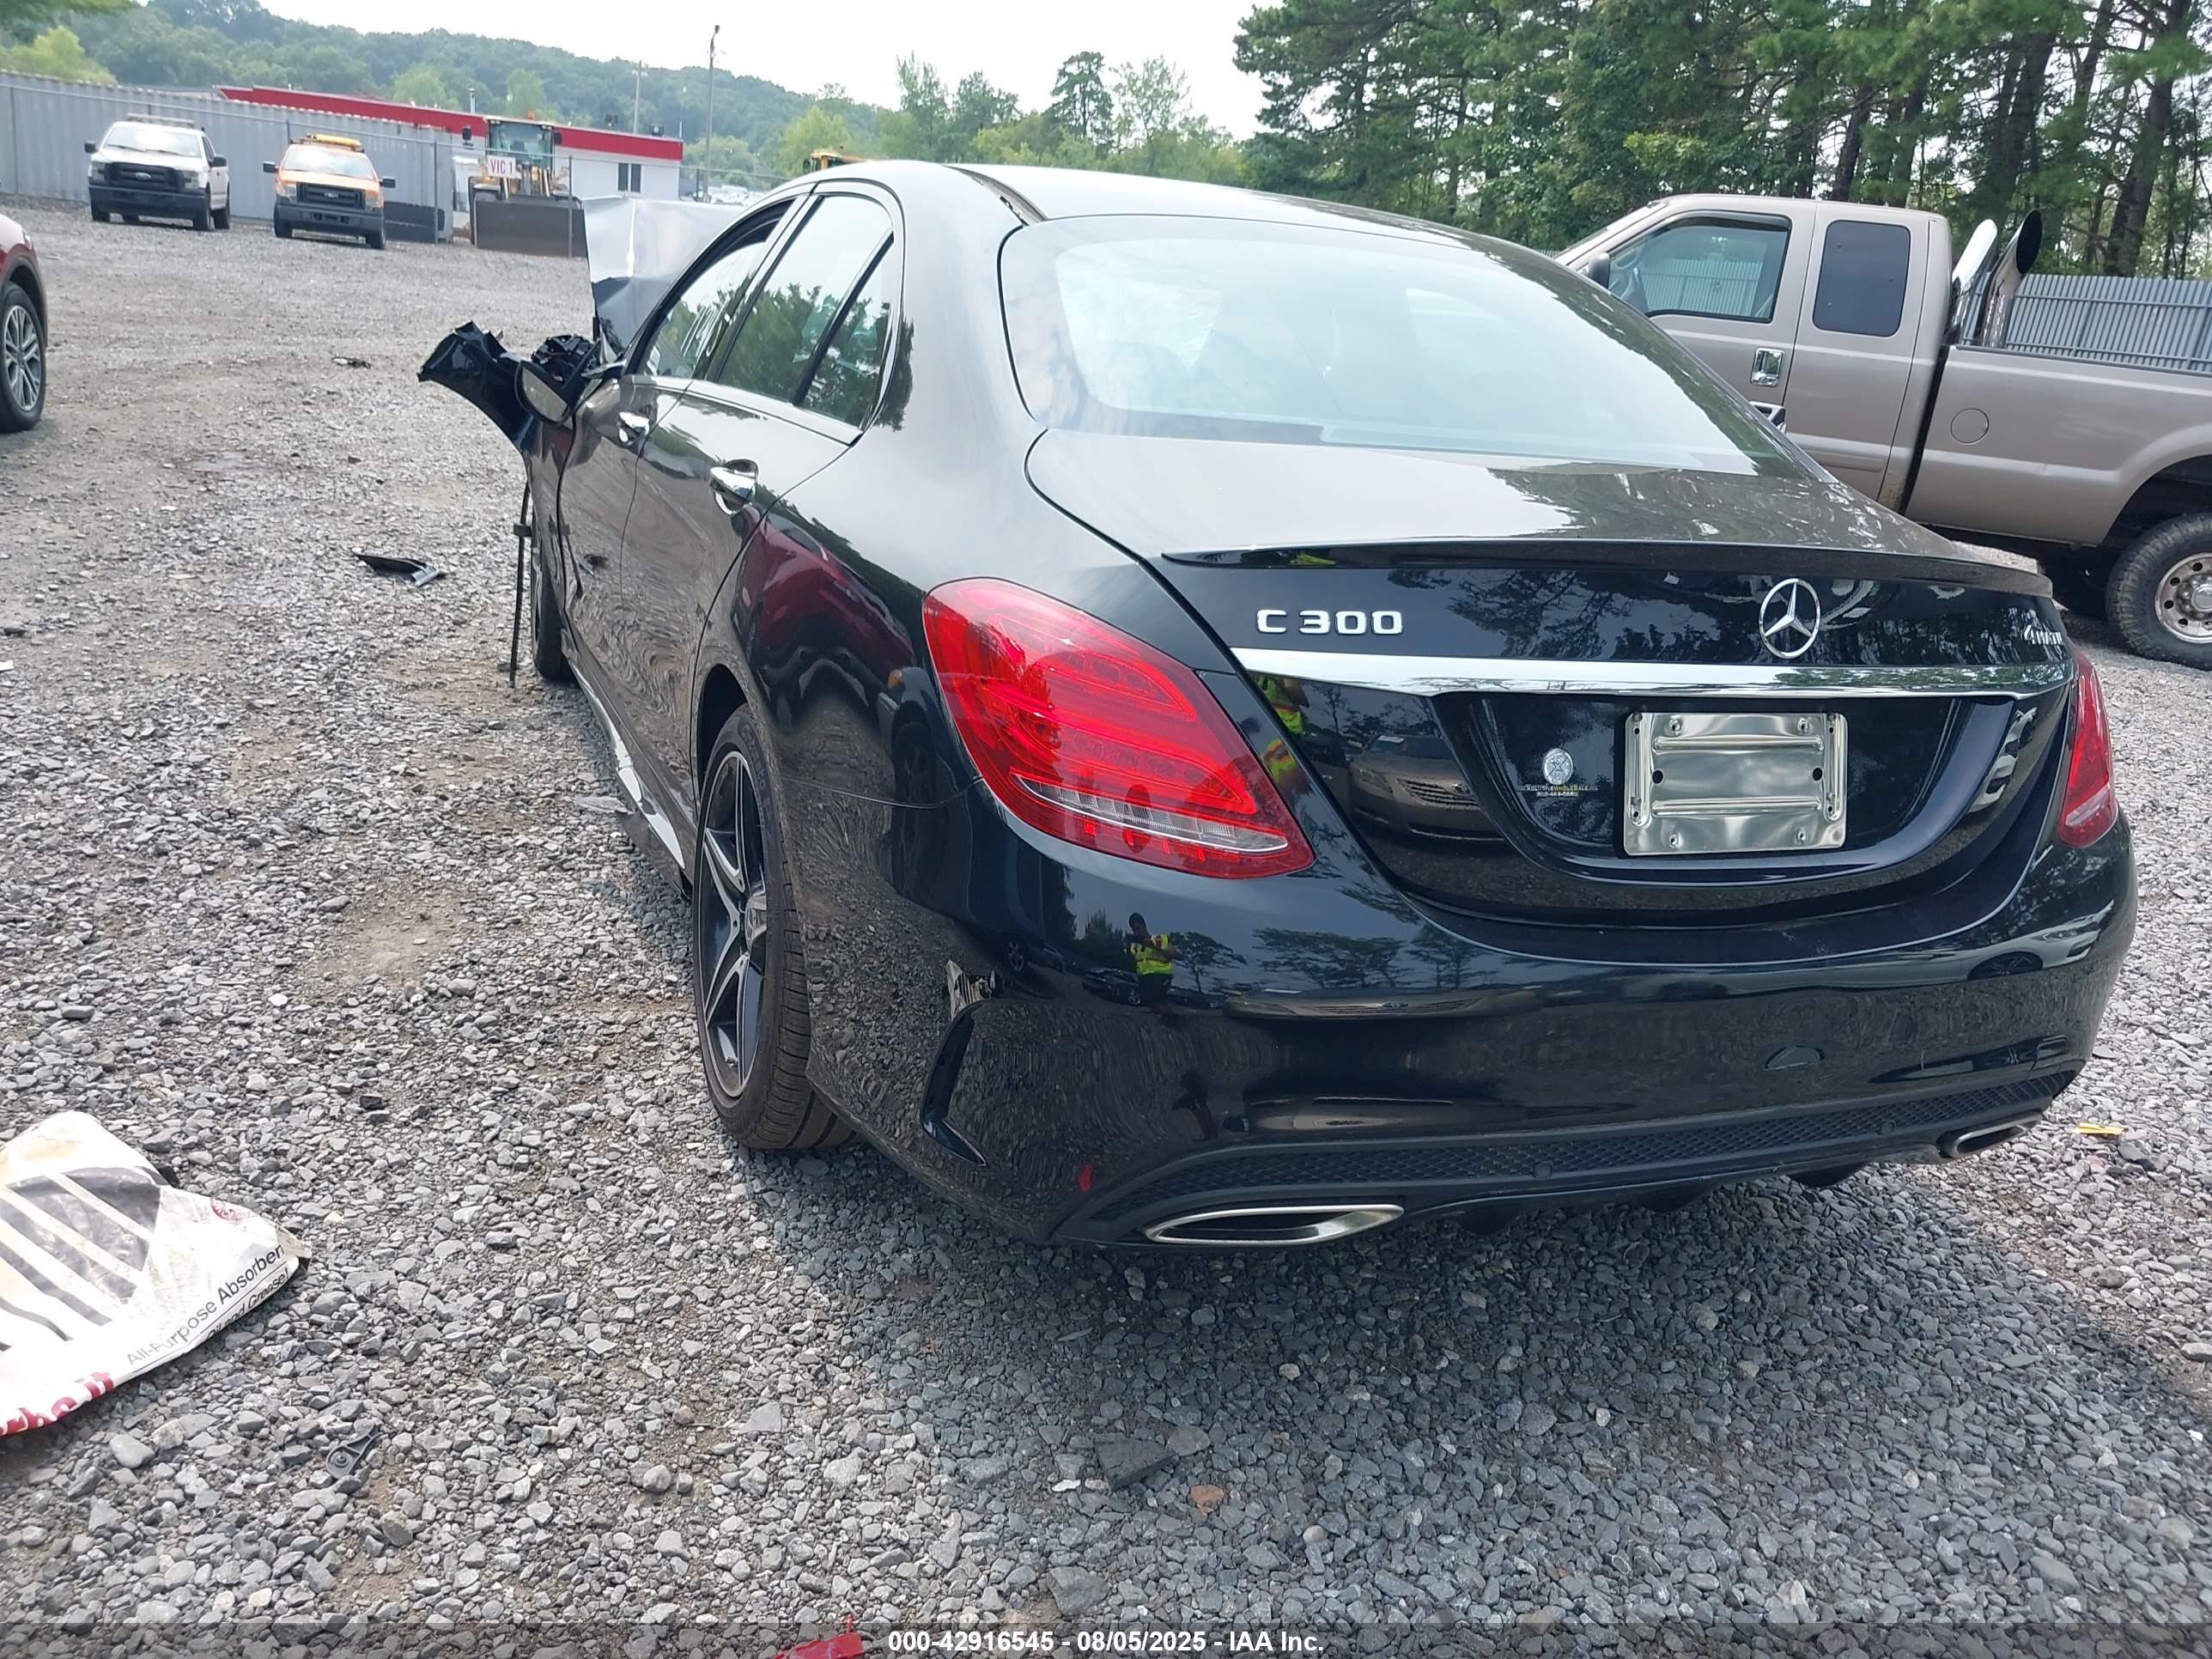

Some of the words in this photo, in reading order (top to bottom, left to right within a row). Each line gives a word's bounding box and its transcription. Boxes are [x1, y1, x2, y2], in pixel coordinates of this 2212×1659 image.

[490, 159, 507, 174] VIC
[509, 161, 514, 174] 1
[1256, 609, 1287, 634] C
[1298, 610, 1403, 635] 300
[127, 1301, 218, 1366] All-Purpose
[217, 1244, 286, 1304] Absorben
